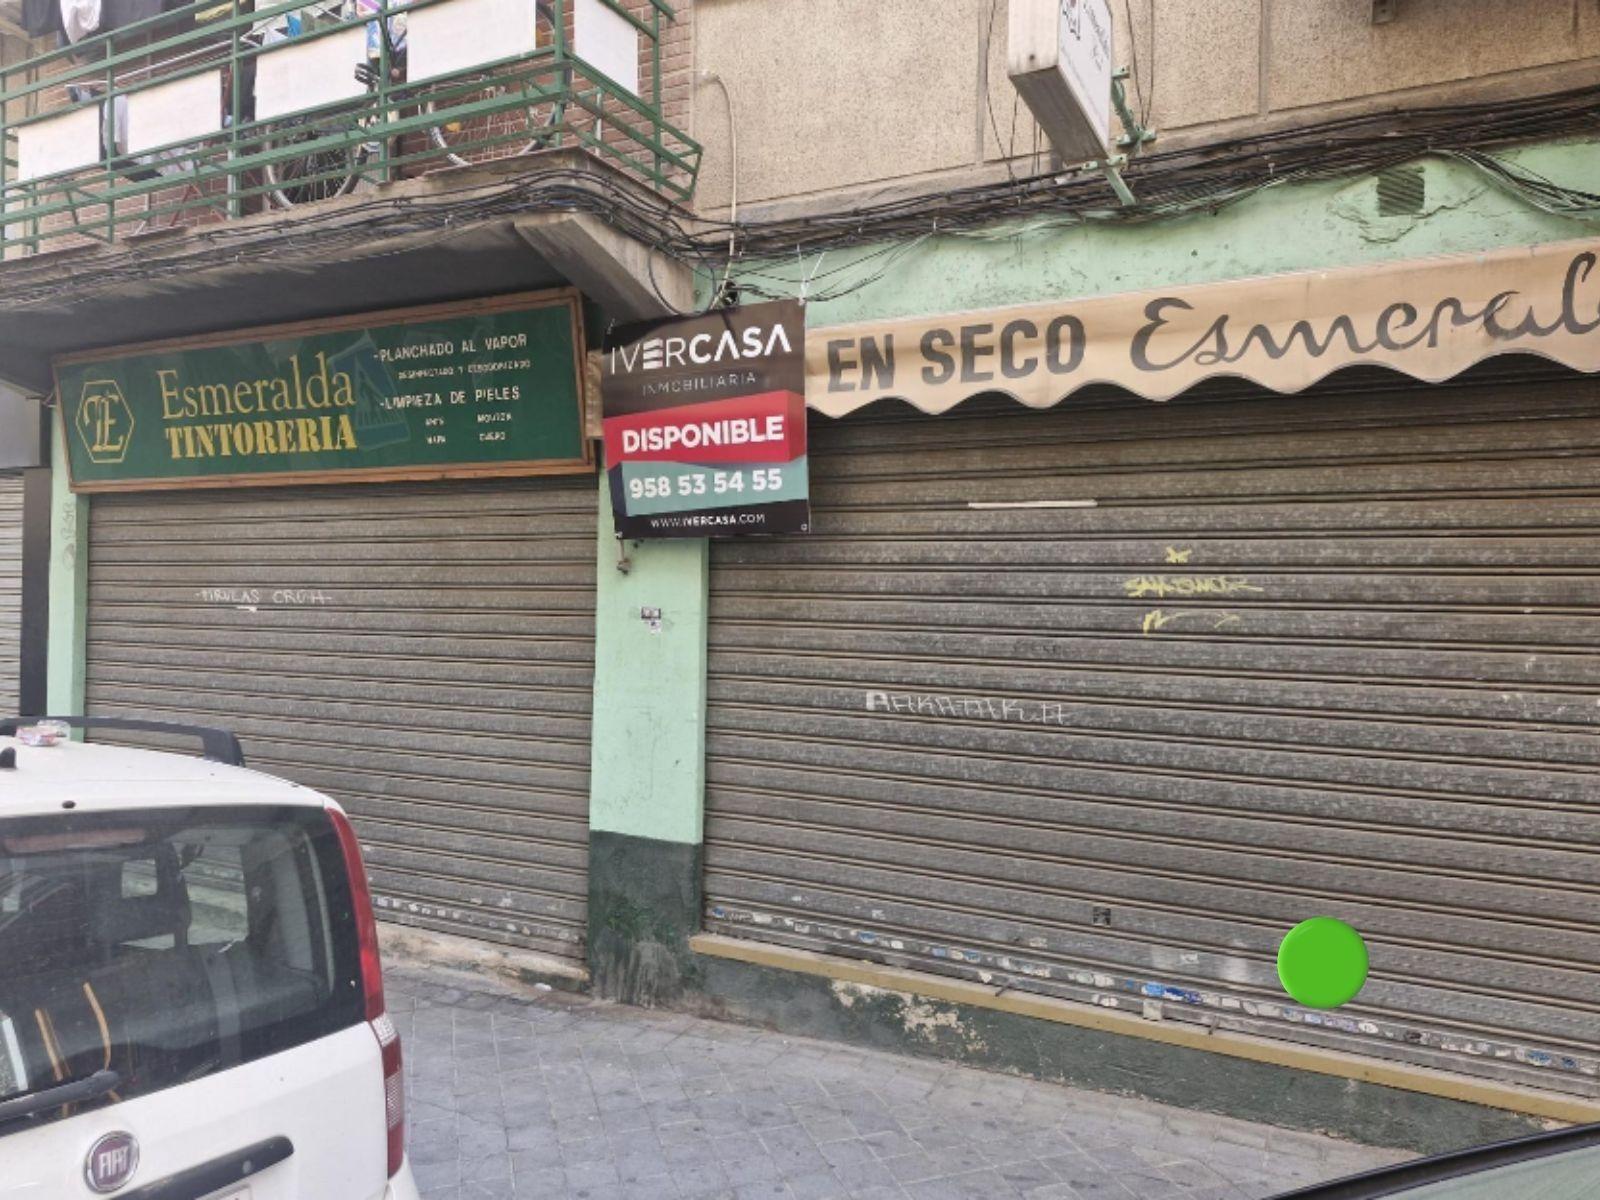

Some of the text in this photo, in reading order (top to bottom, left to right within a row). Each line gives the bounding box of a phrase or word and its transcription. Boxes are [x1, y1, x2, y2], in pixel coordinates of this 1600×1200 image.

[828, 251, 1600, 393] EN SECO Esmeral
[461, 339, 476, 353] AL
[485, 333, 527, 350] VAPOR
[610, 324, 792, 375] IVERCASA
[156, 351, 356, 420] Esmeralda
[450, 391, 466, 404] DE
[475, 385, 520, 402] PIELES
[642, 371, 756, 396] INMOBILIARIA
[165, 414, 357, 459] TINTORERIA
[622, 415, 784, 454] DISPONIBLE
[630, 468, 783, 499] 958 53 54 55
[98, 1146, 129, 1179] FIAT
